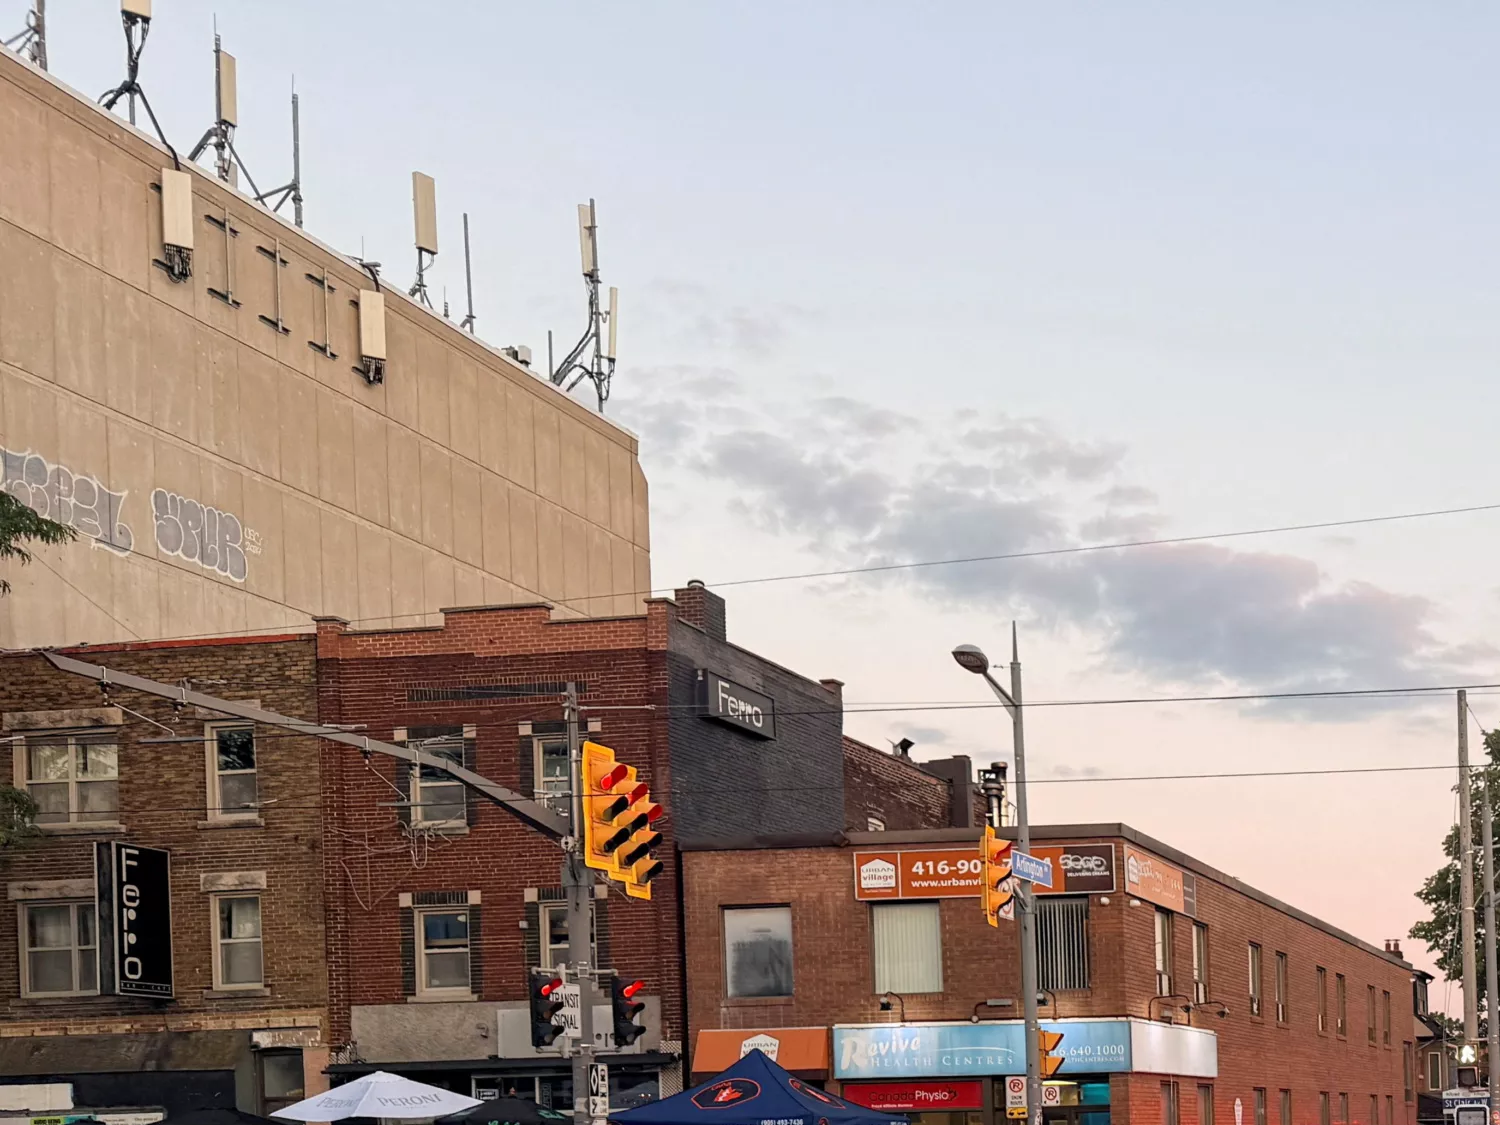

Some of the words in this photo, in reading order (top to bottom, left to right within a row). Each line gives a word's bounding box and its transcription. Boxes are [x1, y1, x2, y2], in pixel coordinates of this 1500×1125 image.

[718, 680, 763, 727] Ferro
[1016, 855, 1044, 879] Arlington
[862, 874, 894, 882] village
[121, 847, 142, 979] Ferro
[550, 992, 579, 1009] TRANSIT
[554, 1014, 579, 1029] SIGNAL
[840, 1036, 920, 1070] Revive
[1051, 1045, 1124, 1057] 16.640.1000
[871, 1057, 932, 1067] HEALTH
[942, 1055, 1013, 1066] CENTRES
[377, 1093, 443, 1107] PERONI
[1445, 1099, 1452, 1107] St
